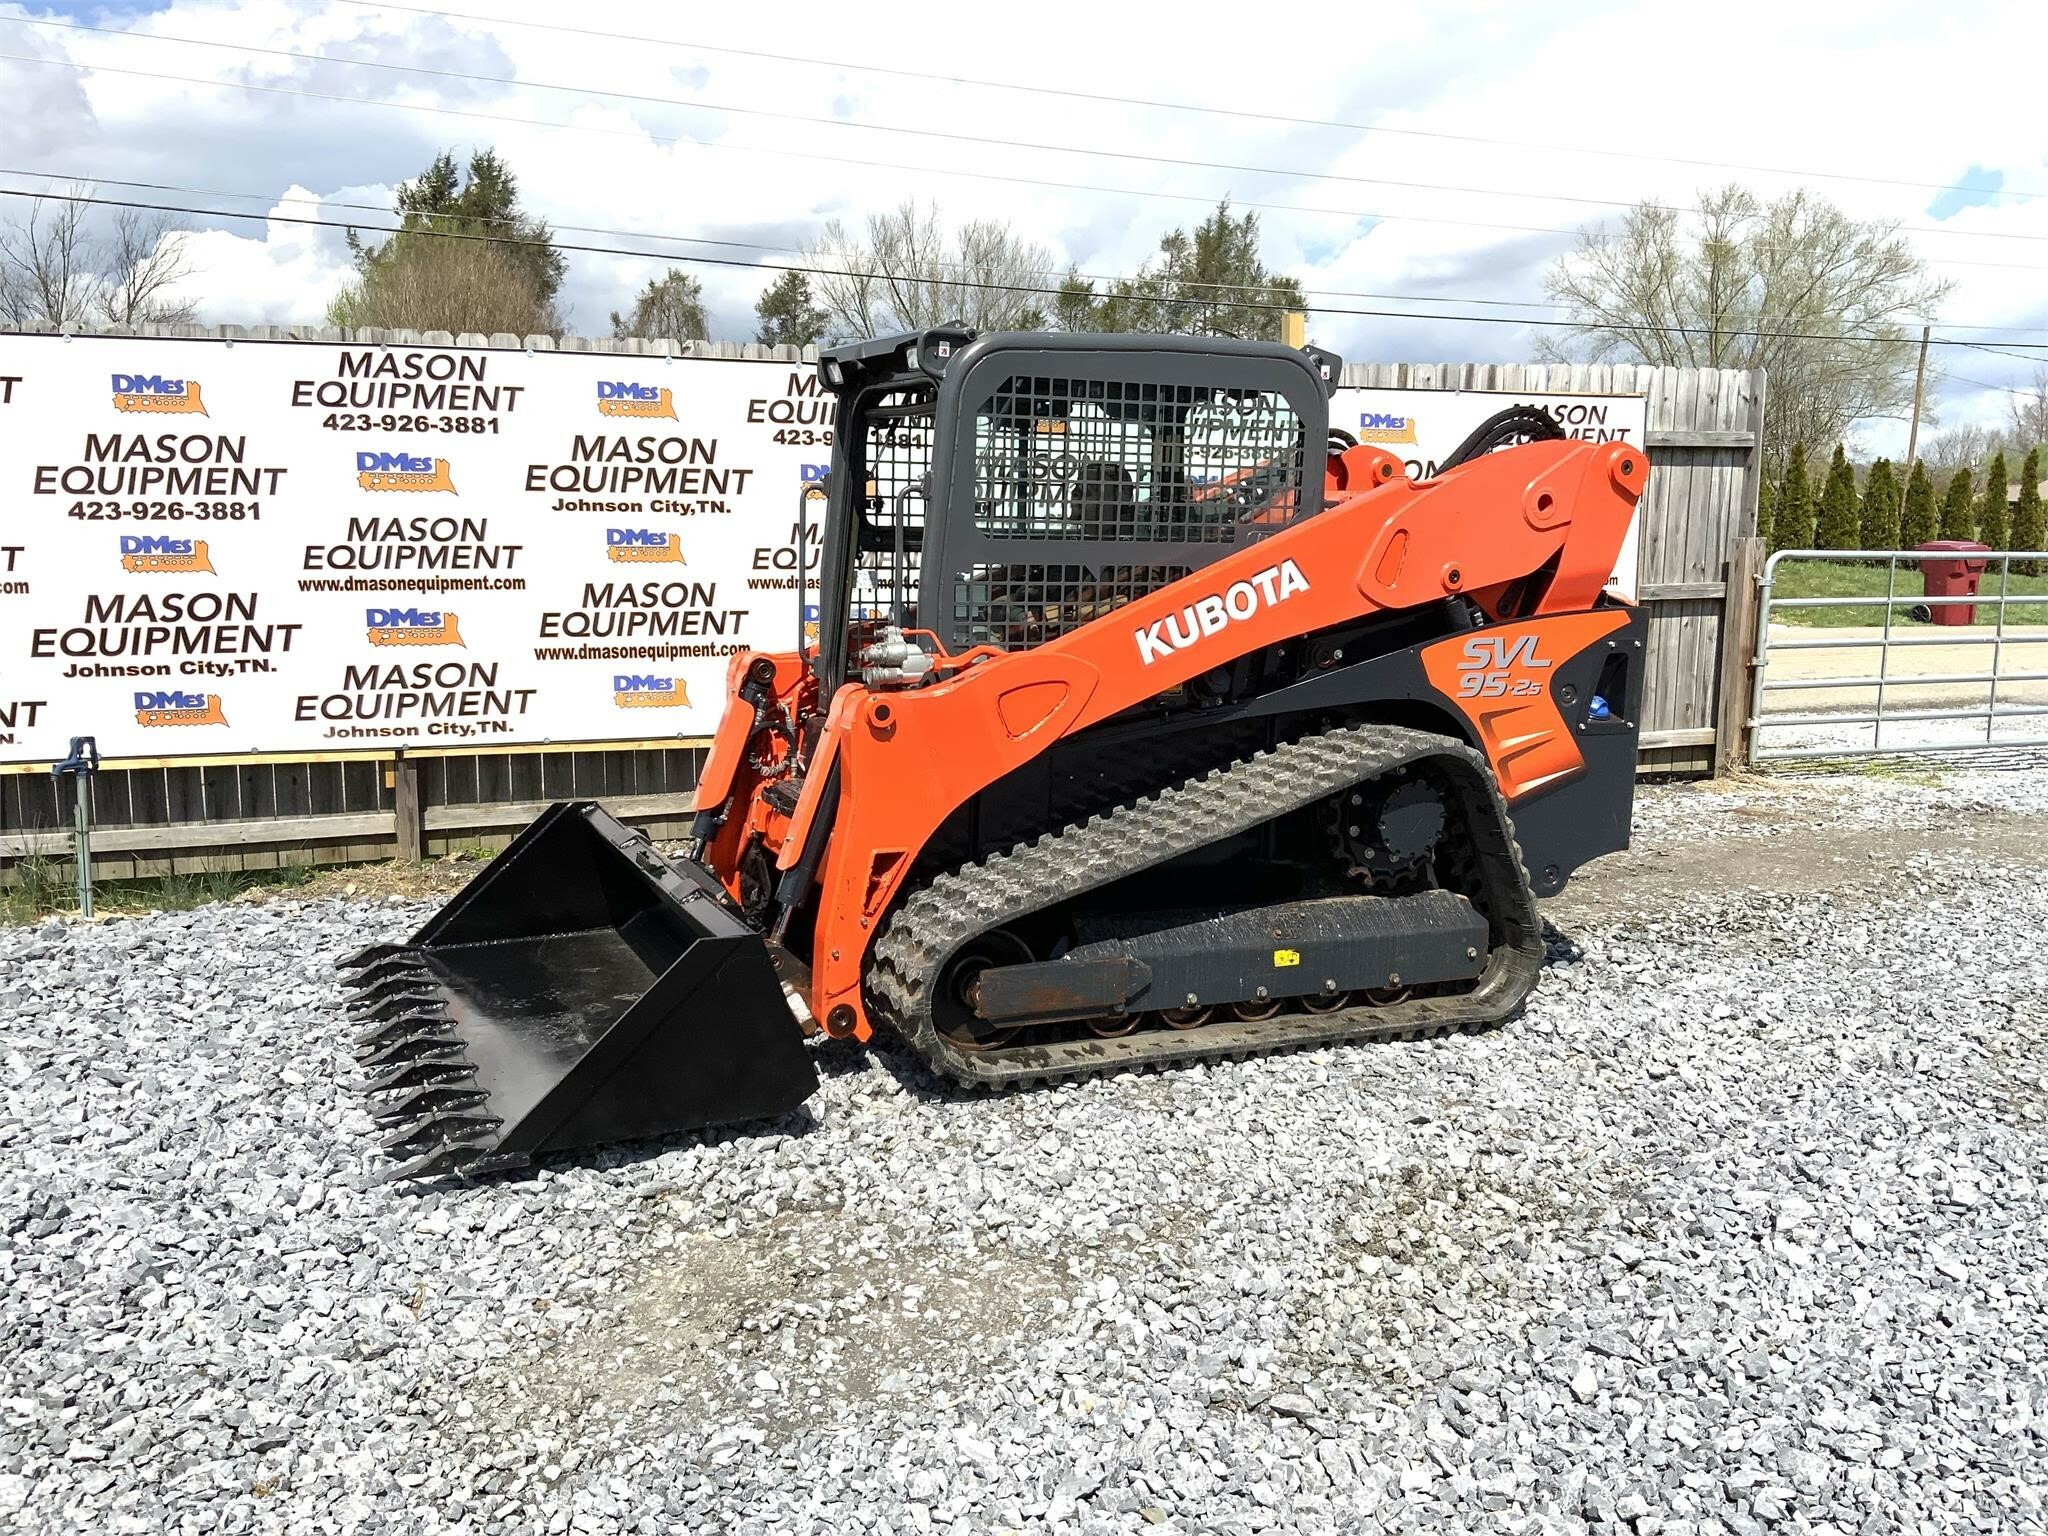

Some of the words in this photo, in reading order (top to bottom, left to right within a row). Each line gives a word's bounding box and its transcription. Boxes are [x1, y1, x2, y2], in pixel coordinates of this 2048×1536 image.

[338, 351, 487, 382] MASON
[291, 380, 525, 412] EQUIPMENT
[322, 413, 499, 434] 423-926-3881
[84, 433, 246, 464] MASON
[571, 434, 718, 465] MASON
[33, 465, 288, 496] EQUIPMENT
[525, 464, 754, 495] EQUIPMENT
[68, 501, 260, 521] 423-926-3881
[551, 498, 643, 513] Johnson
[347, 517, 488, 543] MASON
[303, 544, 523, 570] EQUIPMENT
[297, 574, 526, 595] www.dmasonequipment.com
[582, 582, 716, 609] MASON
[84, 592, 258, 624] MASON
[1134, 558, 1311, 666] KUBOTA
[539, 610, 749, 638] EQUIPMENT
[30, 623, 303, 658] EQUIPMENT
[1456, 635, 1552, 670] SVL
[62, 663, 171, 678] Johnson
[343, 662, 499, 691] MASON
[294, 689, 537, 722] EQUIPMENT
[323, 725, 419, 738] Johnson
